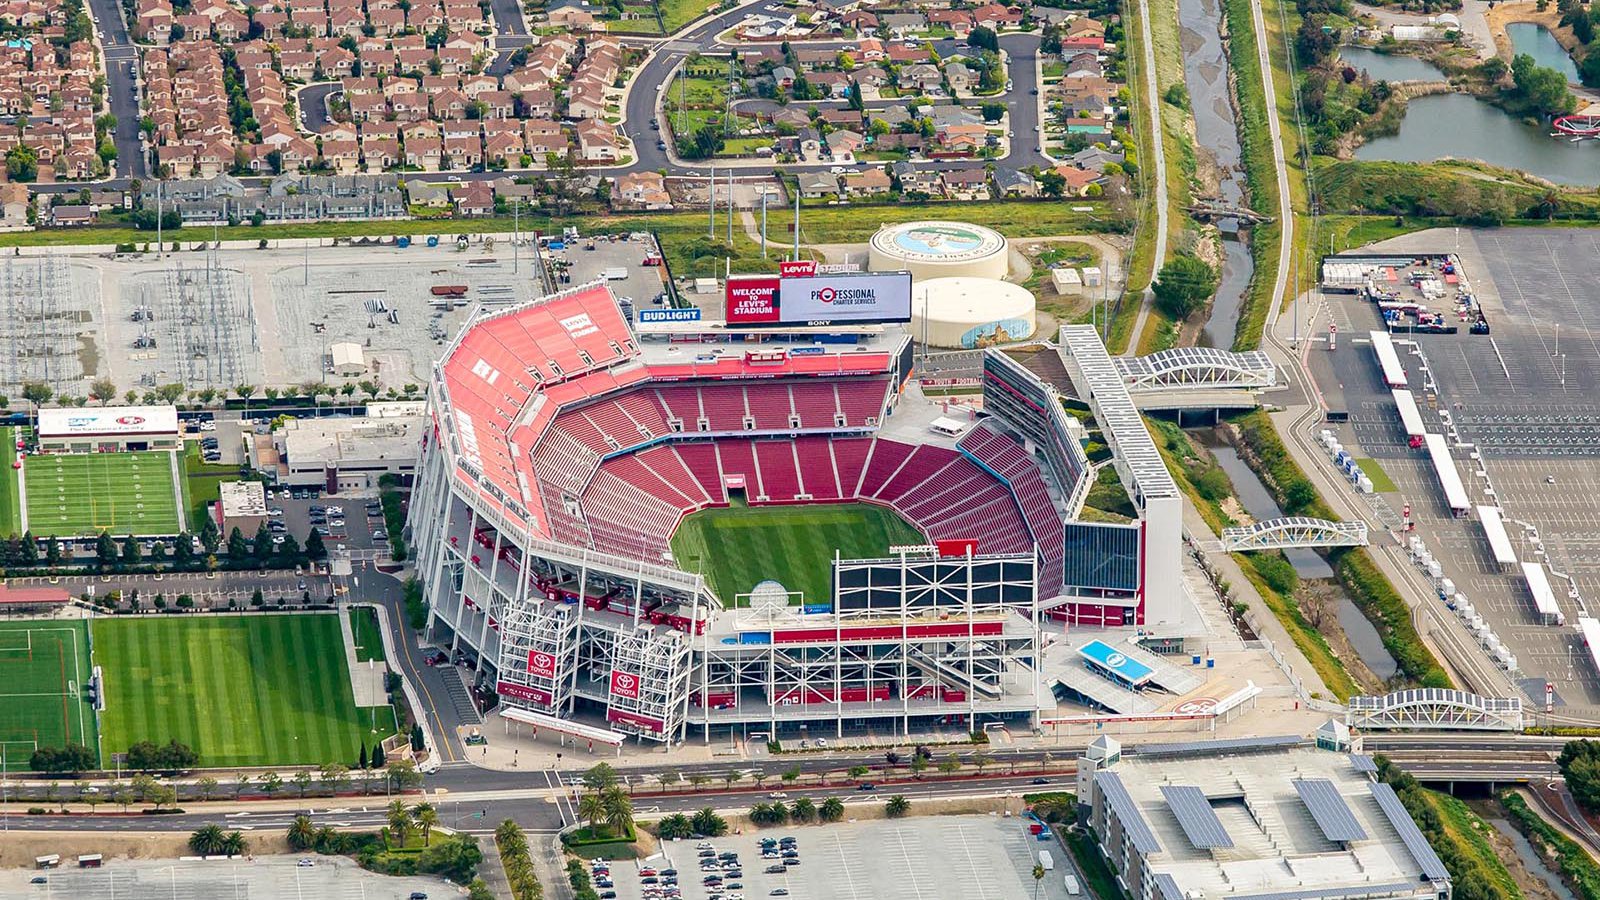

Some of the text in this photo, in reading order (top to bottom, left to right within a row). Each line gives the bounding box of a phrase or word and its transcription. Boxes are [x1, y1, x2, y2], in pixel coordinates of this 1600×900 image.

[734, 307, 773, 315] STADIUM
[530, 665, 553, 676] TOYOTA
[614, 686, 636, 697] TOYOTA
